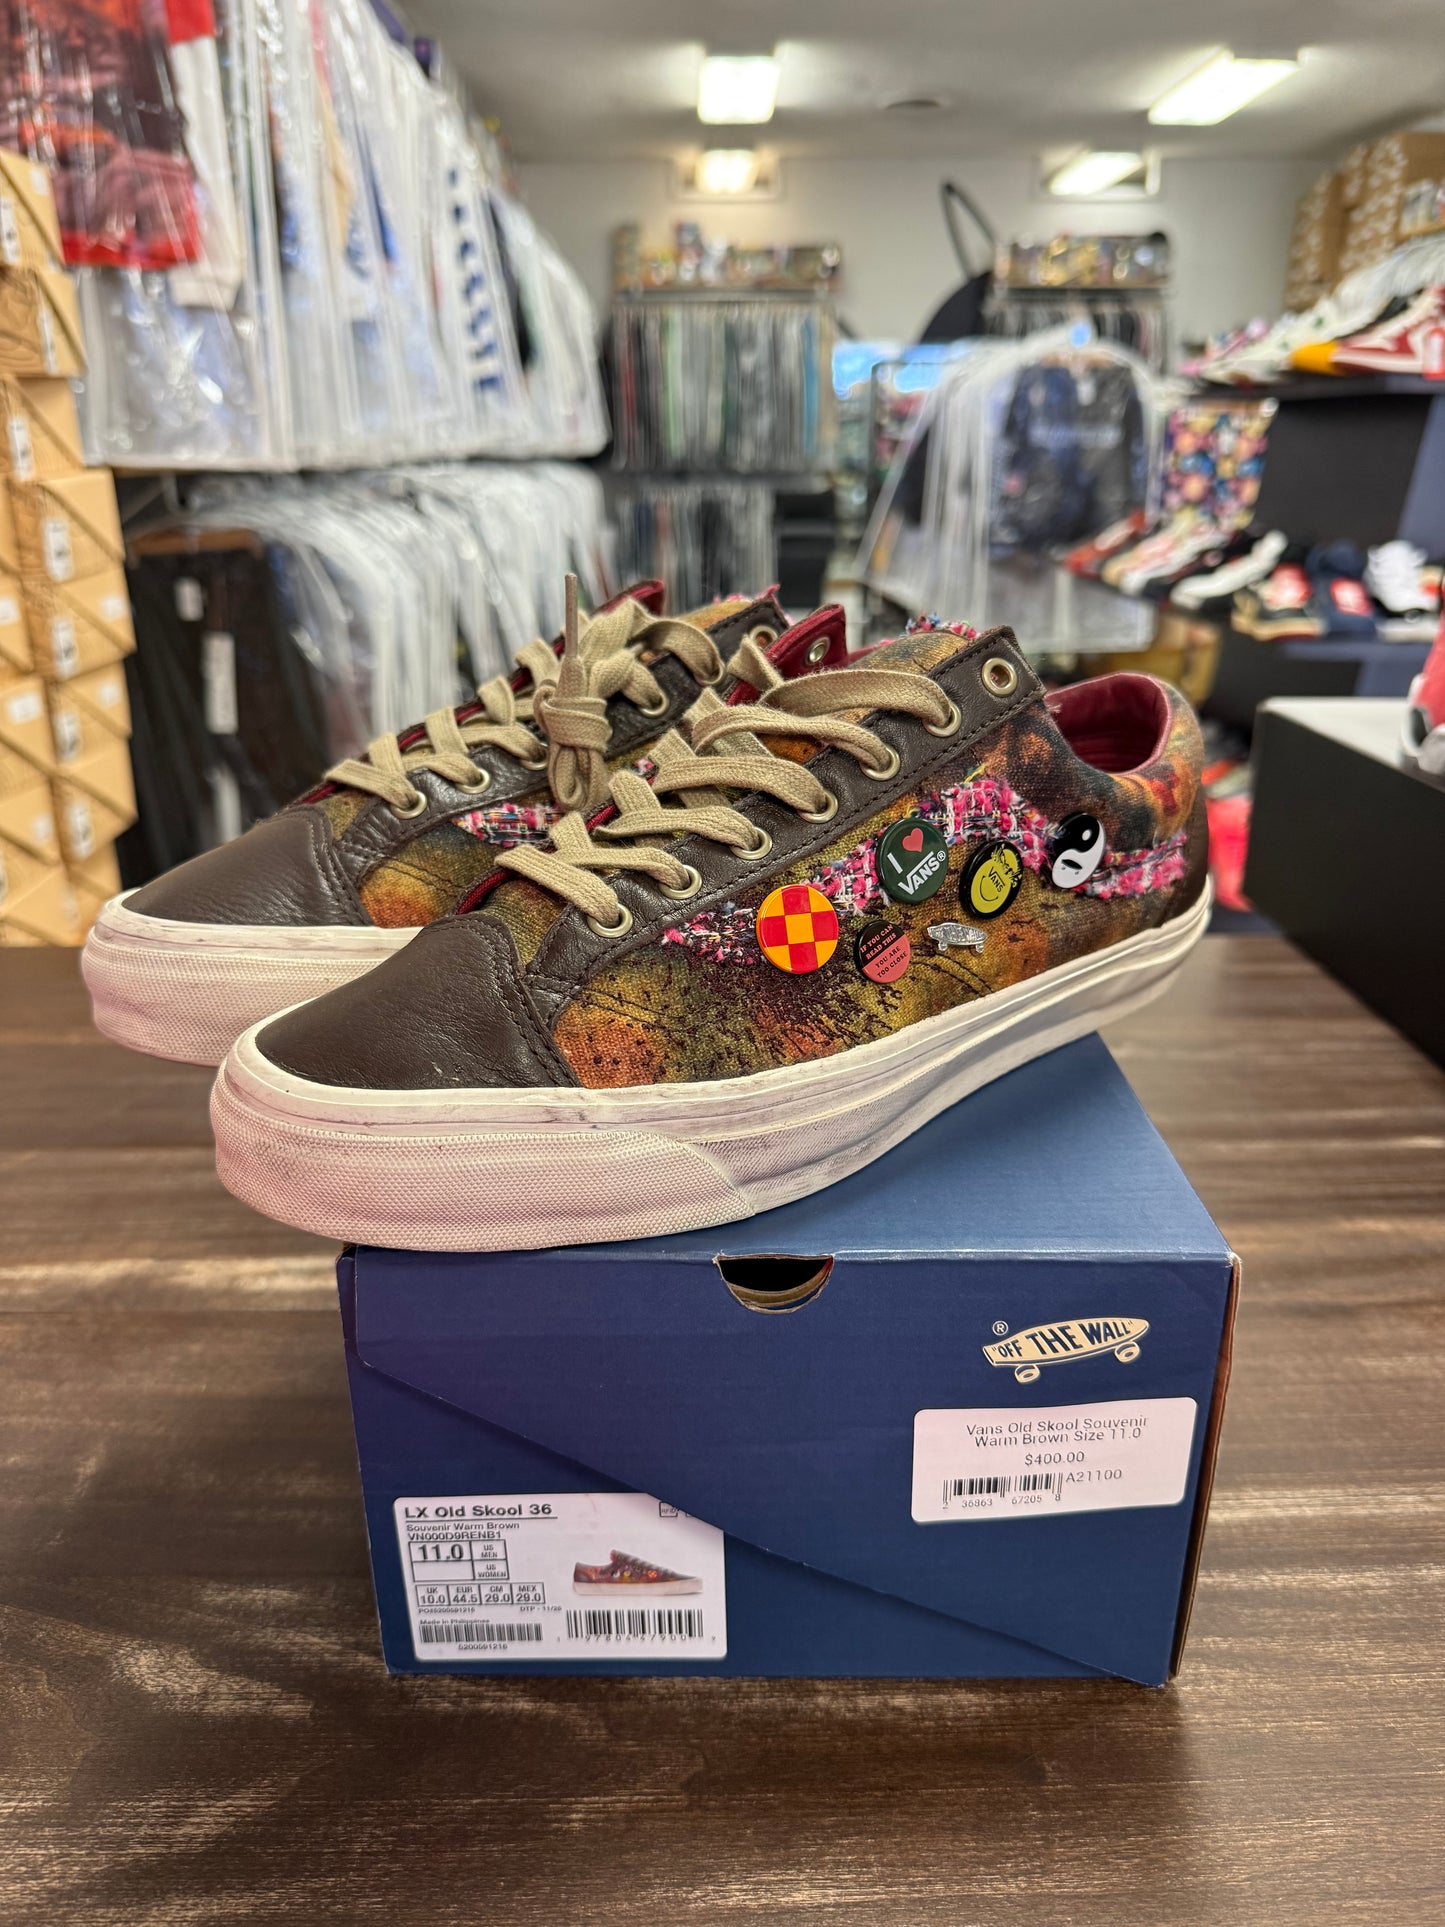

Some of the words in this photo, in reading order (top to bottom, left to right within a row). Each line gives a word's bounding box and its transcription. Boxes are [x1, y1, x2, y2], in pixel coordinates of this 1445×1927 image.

[887, 852, 903, 874] I
[988, 866, 1006, 892] VANS
[860, 945, 867, 953] IF
[867, 934, 880, 947] YOU
[880, 924, 893, 936] CAN
[865, 944, 882, 959] READ
[882, 933, 897, 946] THIS
[875, 956, 888, 968] YOU
[889, 946, 901, 958] ARE
[877, 966, 889, 978] TOO
[890, 951, 908, 968] CLOSE
[1025, 1325, 1083, 1355] THE
[966, 1423, 1003, 1436] Vans
[1008, 1421, 1032, 1433] Old
[1037, 1418, 1079, 1431] Skool
[1083, 1415, 1149, 1429] Souvenir
[974, 1435, 1018, 1447] Warm
[1022, 1432, 1069, 1445] Brown
[1074, 1430, 1105, 1442] Size
[1110, 1427, 1141, 1440] 11.0
[1024, 1451, 1085, 1466] $400.00
[1065, 1468, 1122, 1483] A21100
[961, 1498, 993, 1508] 36863
[1011, 1494, 1042, 1505] 67205
[405, 1506, 428, 1518] LX
[435, 1505, 466, 1517] Old
[472, 1504, 522, 1516] Skool
[529, 1503, 552, 1515] 36
[406, 1523, 451, 1531] Souvenir
[453, 1522, 484, 1530] Warm
[486, 1521, 520, 1529] Brown
[418, 1543, 464, 1560] 11.0
[490, 1585, 503, 1593] CM
[518, 1584, 536, 1592] MEX
[420, 1595, 445, 1604] 10.0
[453, 1594, 478, 1603] 44.5
[485, 1593, 510, 1603] 29.0
[516, 1592, 541, 1602] 29.0
